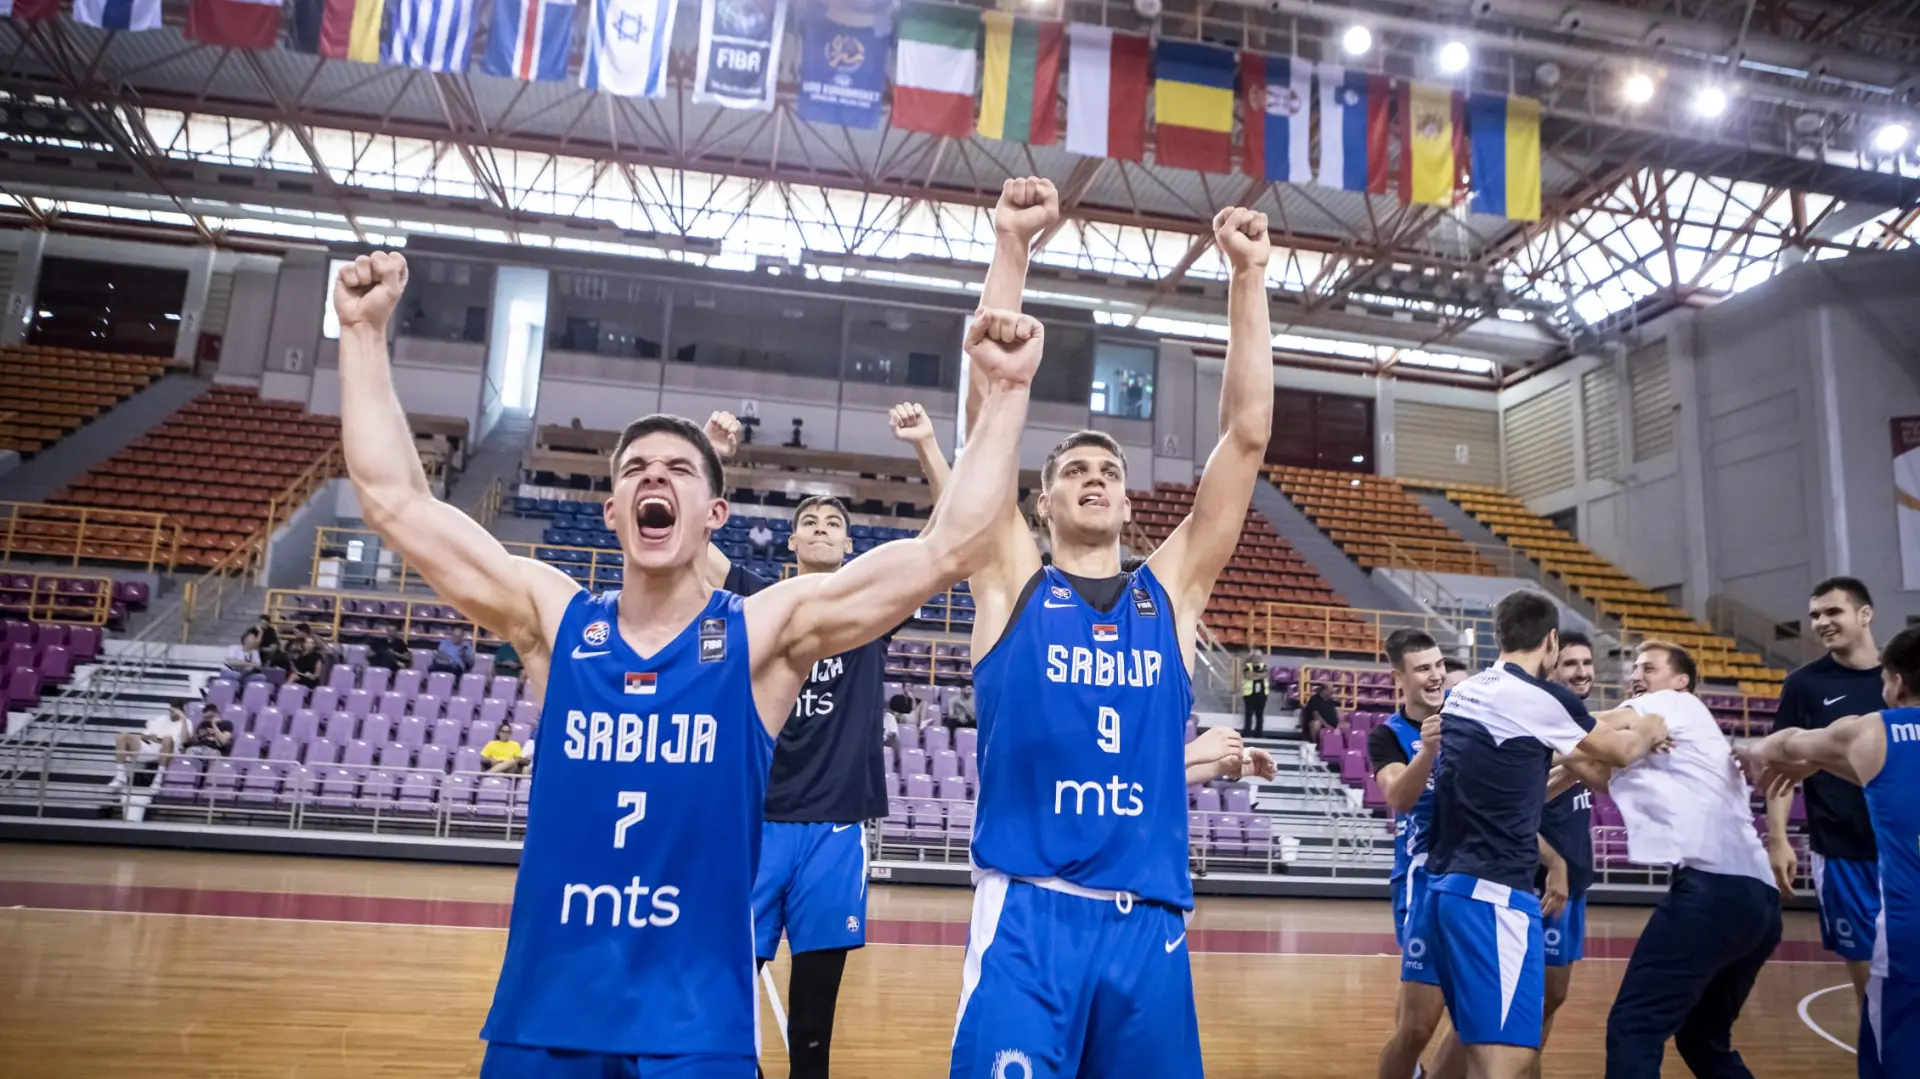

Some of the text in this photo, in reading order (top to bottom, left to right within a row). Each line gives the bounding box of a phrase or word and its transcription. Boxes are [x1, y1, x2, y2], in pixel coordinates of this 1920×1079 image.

[716, 47, 761, 73] FIBA
[703, 639, 723, 650] FIBA
[1046, 644, 1162, 688] SRBIJA
[564, 710, 718, 763] SRBIJA
[1096, 706, 1121, 753] 9
[1055, 775, 1144, 816] mts
[613, 791, 647, 849] 7
[560, 875, 681, 928] mts
